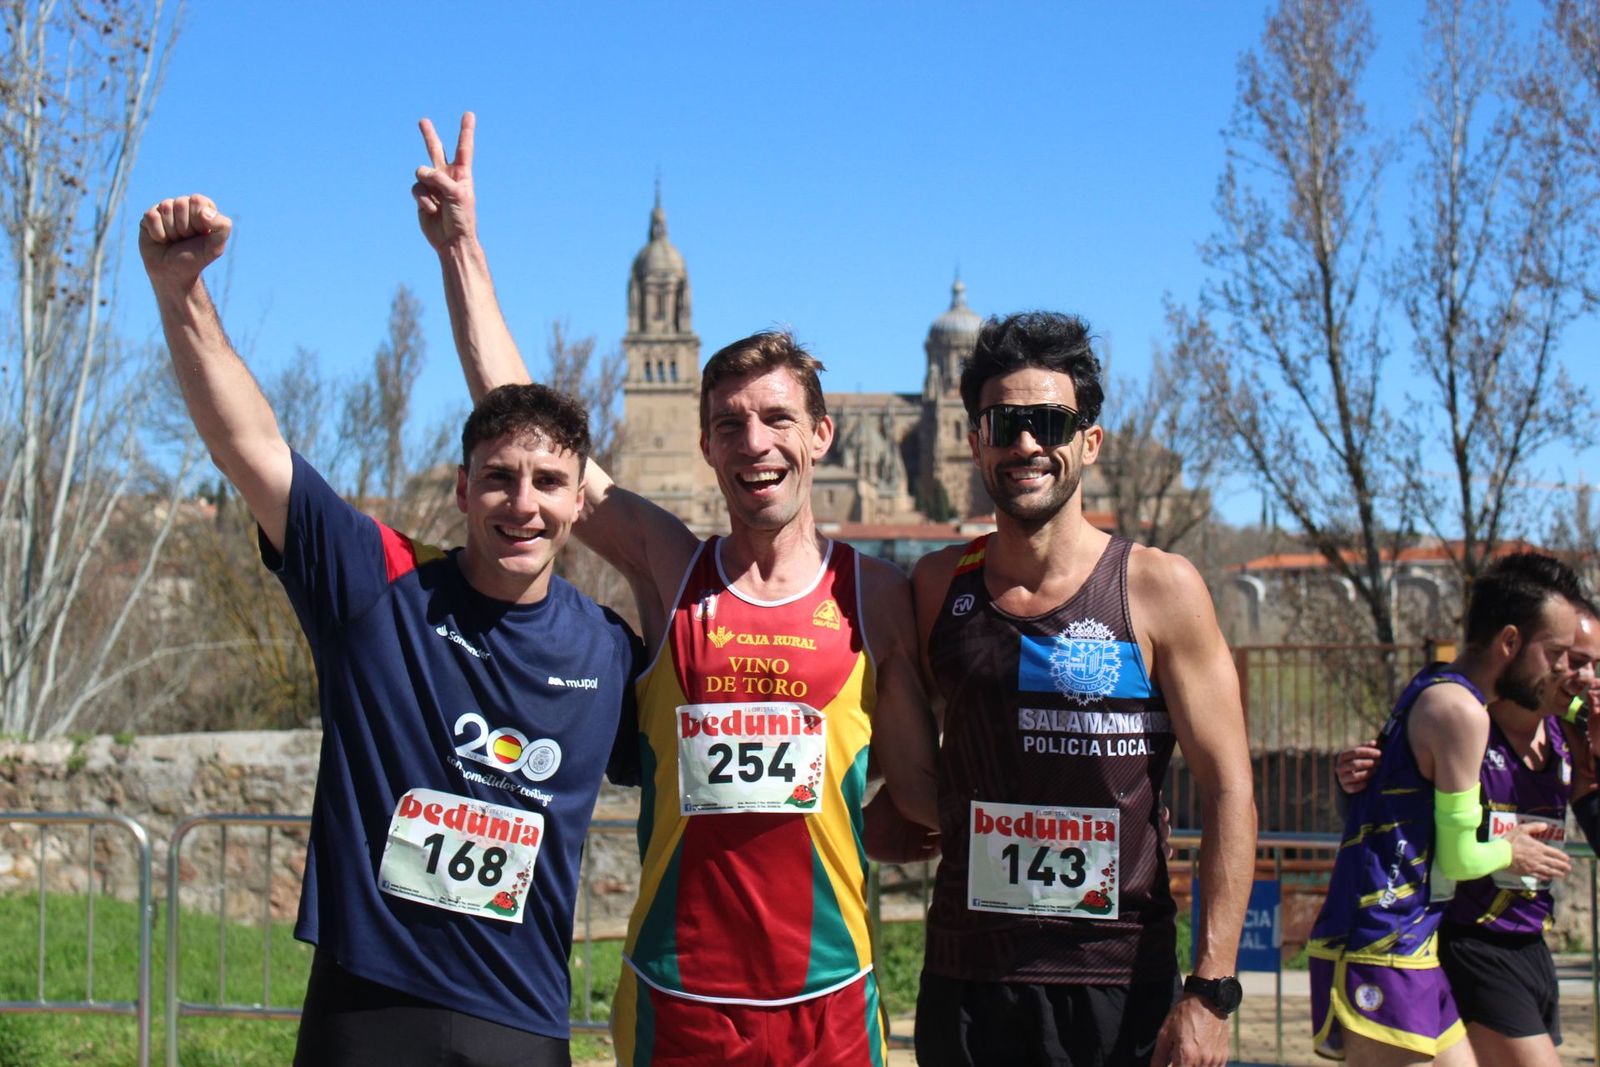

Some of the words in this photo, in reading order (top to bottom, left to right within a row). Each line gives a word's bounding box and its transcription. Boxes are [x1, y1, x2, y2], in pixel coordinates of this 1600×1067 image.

[737, 634, 770, 646] CAJA
[773, 635, 817, 650] RURAL
[728, 656, 790, 675] VINO
[566, 677, 598, 690] mupol
[705, 676, 736, 693] DE
[742, 677, 808, 698] TORO
[681, 710, 822, 738] bedunia
[1021, 708, 1152, 733] SALAMANCA
[454, 712, 562, 781] 200
[1023, 736, 1101, 756] POLICIA
[1107, 738, 1155, 756] LOCAL
[708, 742, 796, 784] 254
[398, 795, 540, 847] bedunia
[975, 808, 1115, 842] bedunia
[423, 833, 507, 887] 168
[1002, 843, 1086, 888] 143
